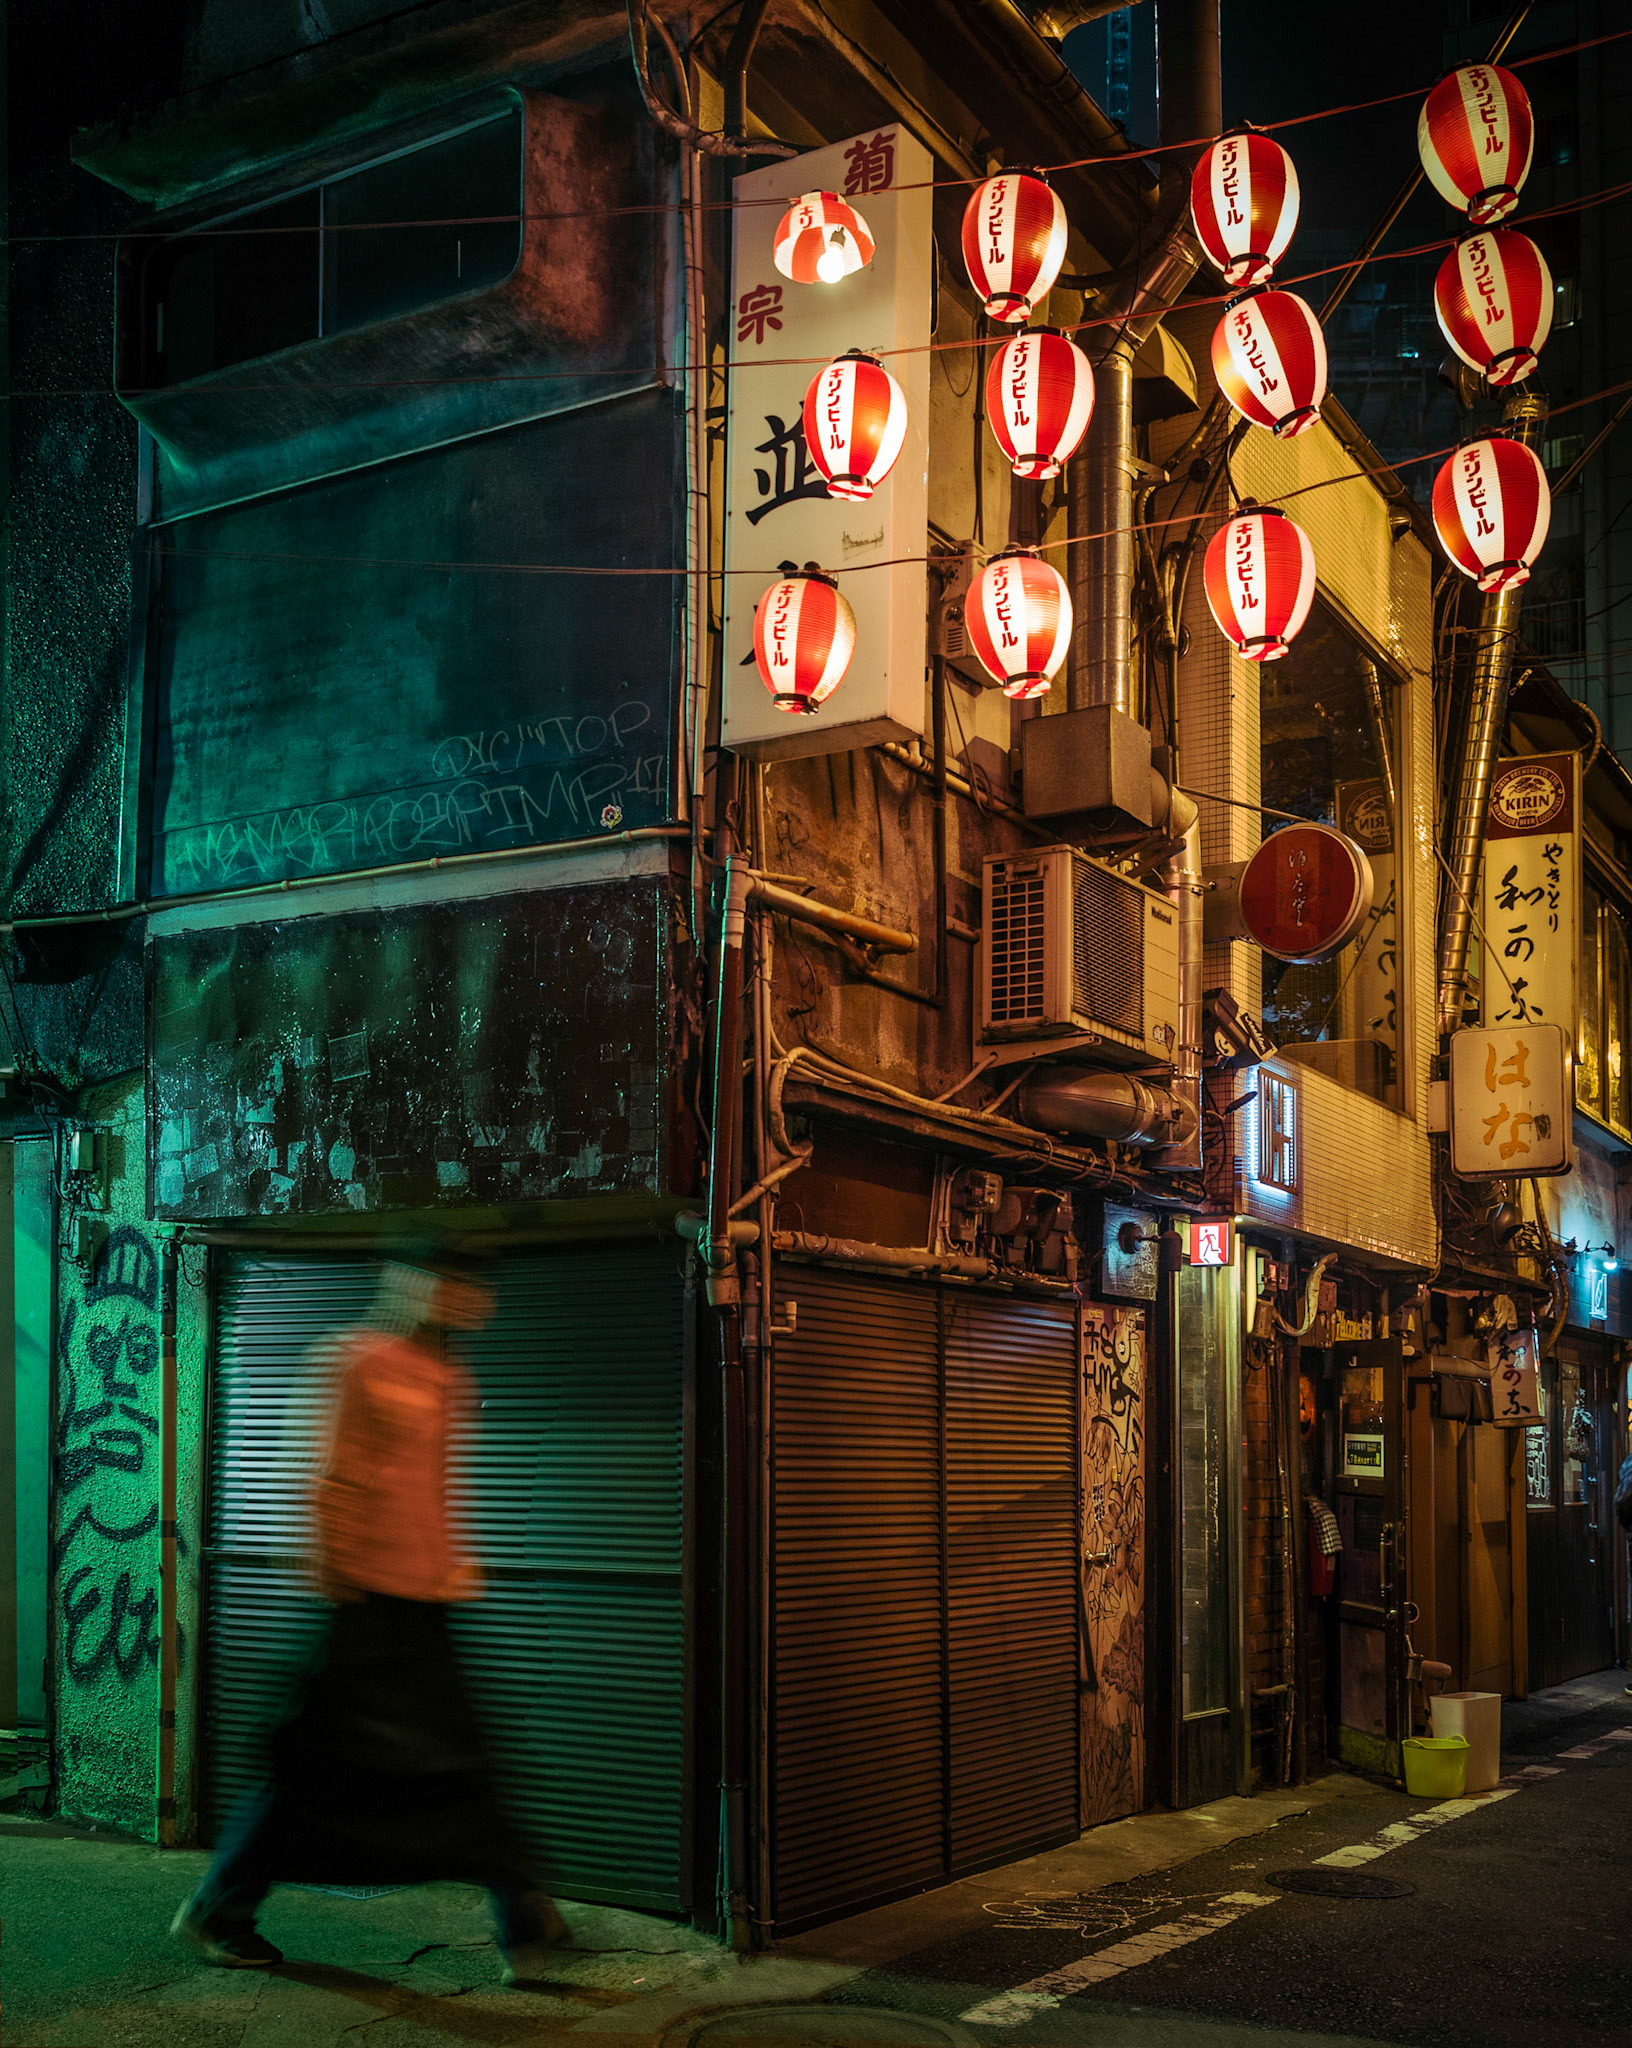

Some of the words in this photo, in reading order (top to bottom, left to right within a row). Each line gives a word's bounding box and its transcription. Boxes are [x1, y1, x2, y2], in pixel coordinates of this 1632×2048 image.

[1467, 68, 1503, 155] キリンビール
[989, 179, 1008, 264] キリンビール
[1222, 140, 1244, 226] キリンビール
[1467, 238, 1504, 326] キリンビール
[1011, 341, 1030, 427] キリンビール
[1233, 310, 1278, 396] キリンビール
[827, 368, 845, 450] キリンビール
[1463, 449, 1495, 537] キリンビール
[993, 566, 1018, 648] キリンビール
[1236, 522, 1258, 610] キリンビール
[773, 584, 795, 667] キリンビール
[1506, 795, 1549, 811] KIRIN
[1519, 817, 1536, 826] BEER
[1151, 906, 1172, 926] National
[1542, 842, 1563, 933] やきとり
[1482, 1040, 1535, 1160] はな
